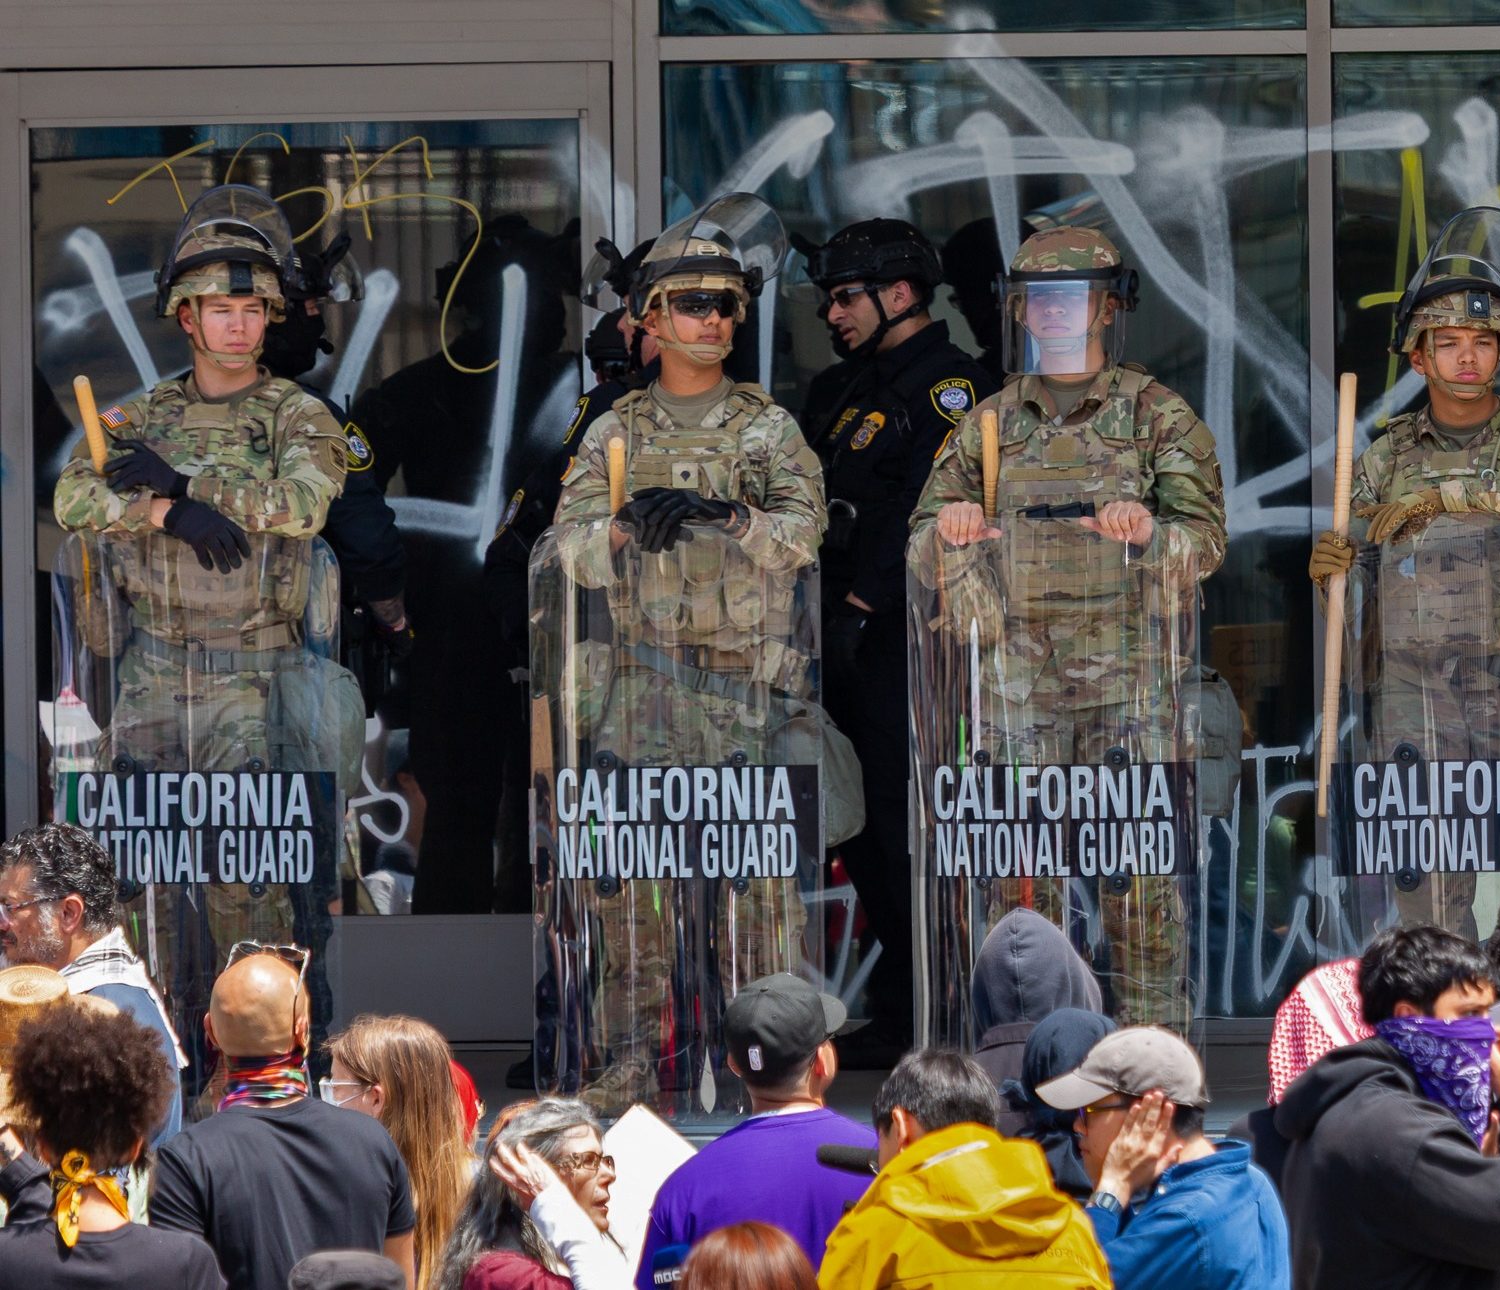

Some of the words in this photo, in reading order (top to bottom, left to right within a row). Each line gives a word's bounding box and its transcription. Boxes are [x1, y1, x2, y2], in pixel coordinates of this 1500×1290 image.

[934, 380, 968, 394] POLICE
[77, 772, 313, 828] CALIFORNIA
[556, 766, 797, 823] CALIFORNIA
[933, 764, 1173, 820] CALIFORNIA
[88, 829, 209, 885] TIONAL
[218, 829, 314, 884] GUARD
[558, 824, 693, 879] NATIONAL
[701, 823, 798, 879] GUARD
[936, 822, 1071, 878] NATIONAL
[1078, 821, 1175, 877] GUARD
[1355, 818, 1495, 875] NATIONAL
